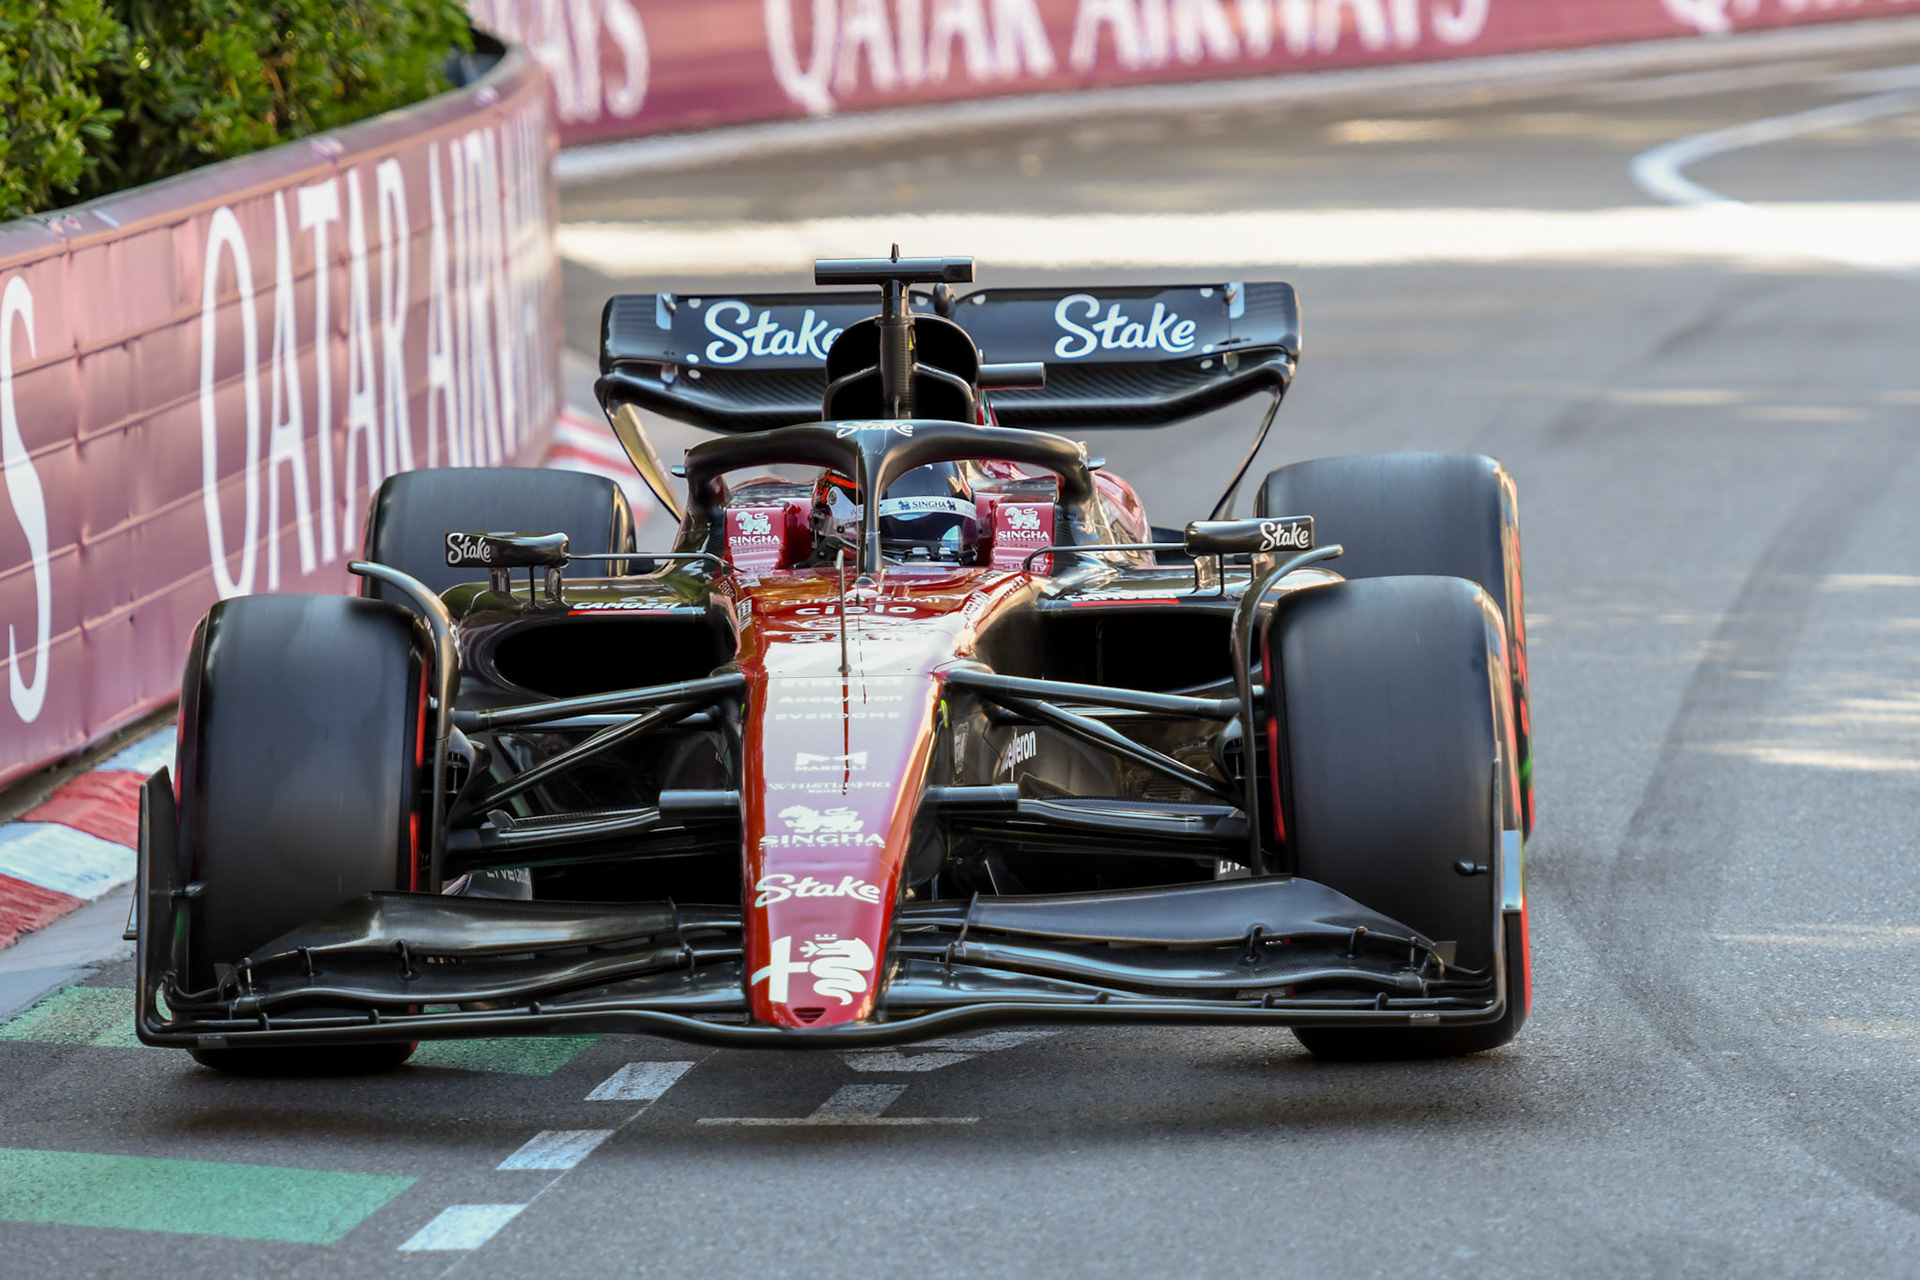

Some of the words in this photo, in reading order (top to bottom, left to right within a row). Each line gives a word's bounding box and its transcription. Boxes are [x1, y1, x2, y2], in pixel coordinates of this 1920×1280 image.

[704, 300, 845, 364] Stake
[1054, 293, 1197, 359] Stake
[836, 420, 914, 439] Stake
[912, 500, 947, 508] SINGHA
[728, 534, 781, 544] SINGHA
[997, 530, 1050, 539] SINGHA
[1259, 521, 1309, 552] Stake
[446, 532, 492, 564] Stake
[573, 601, 682, 610] CAMOZZI
[794, 764, 867, 772] MARELLI
[758, 833, 885, 845] SINGHA
[755, 874, 881, 908] Stake
